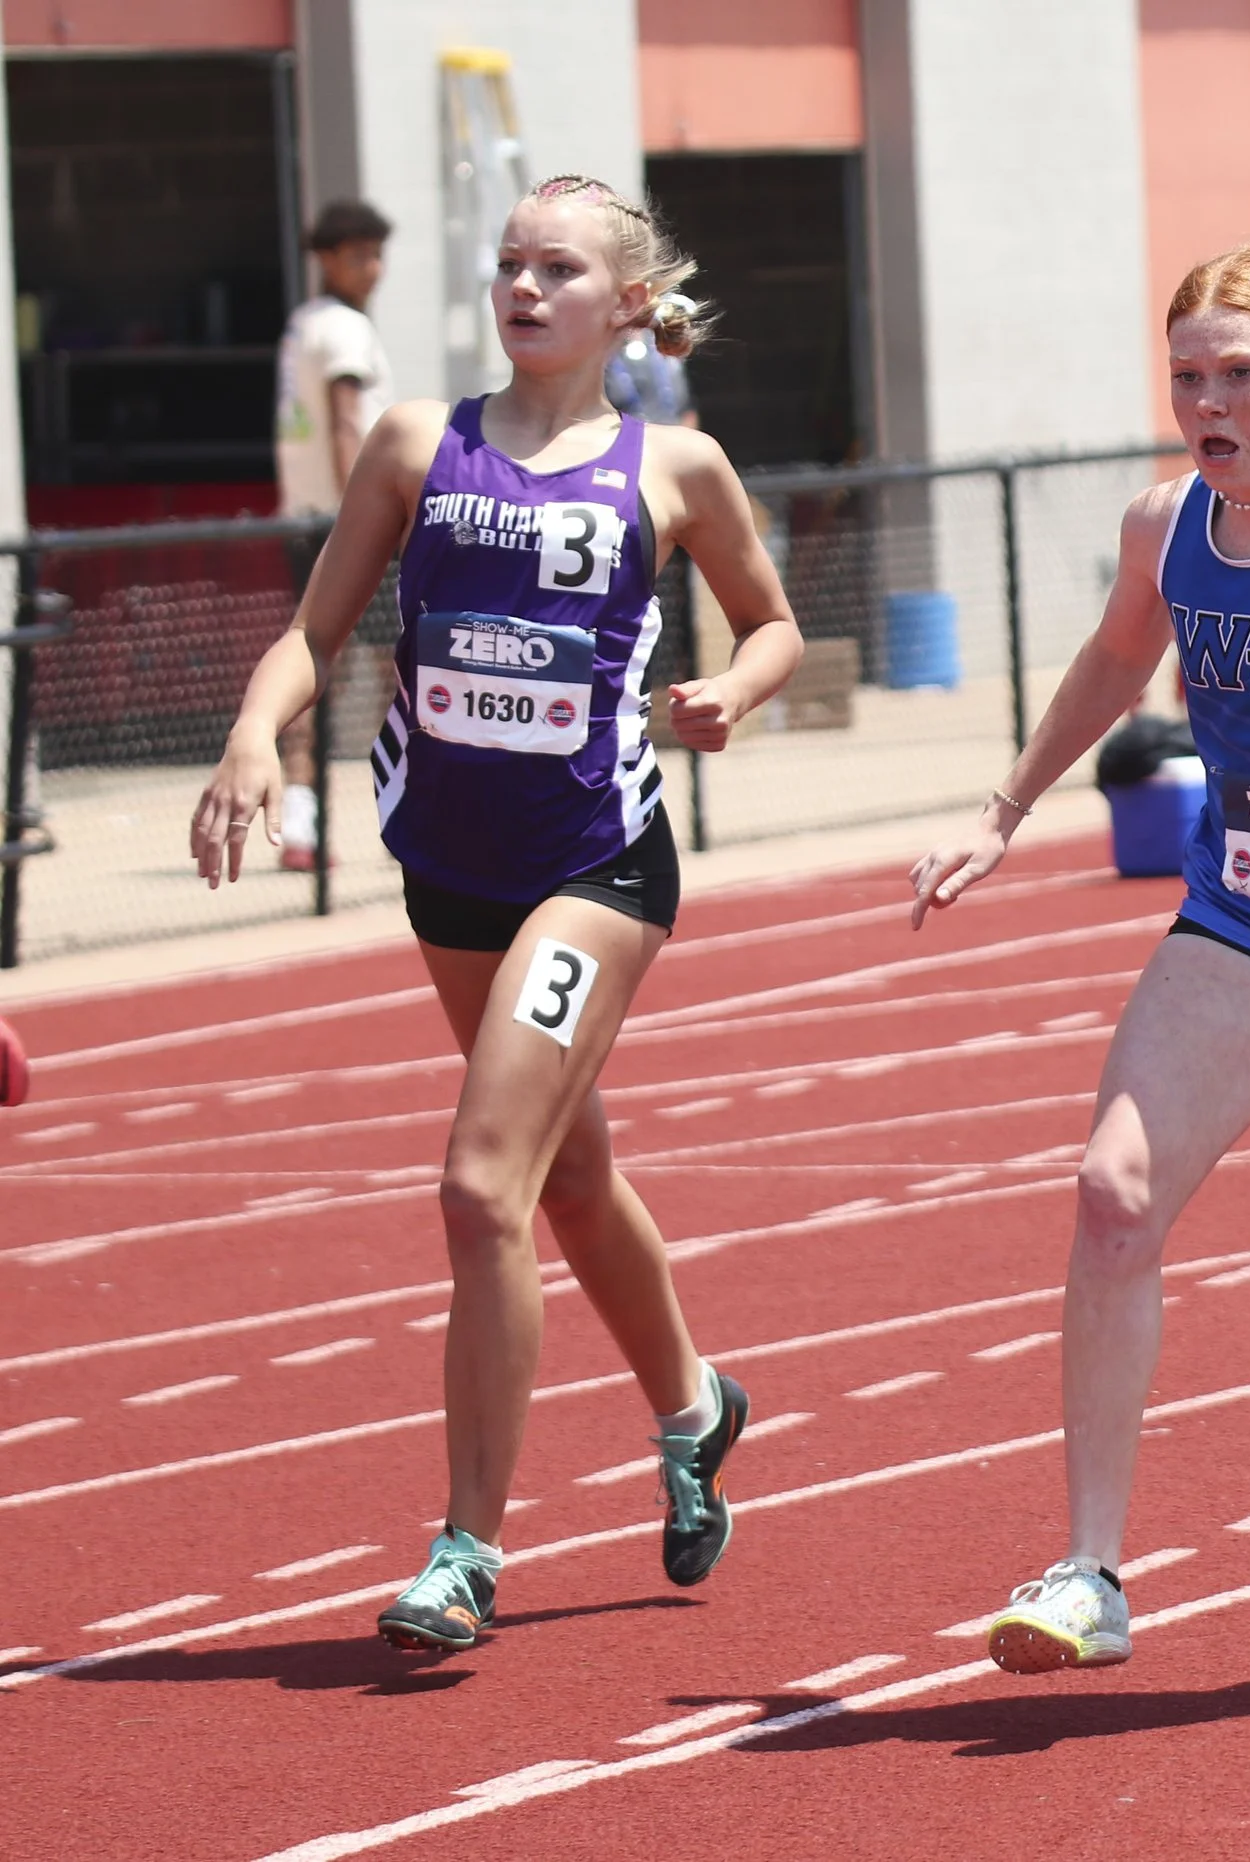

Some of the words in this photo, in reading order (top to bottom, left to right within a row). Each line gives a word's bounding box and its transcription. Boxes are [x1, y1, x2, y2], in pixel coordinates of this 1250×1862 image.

[424, 493, 495, 526] SOUTH
[478, 528, 622, 568] BULLS
[553, 508, 597, 587] 3
[449, 628, 554, 668] ZERO
[472, 621, 531, 637] SHOW-ME
[463, 690, 535, 724] 1630
[530, 949, 583, 1029] 3
